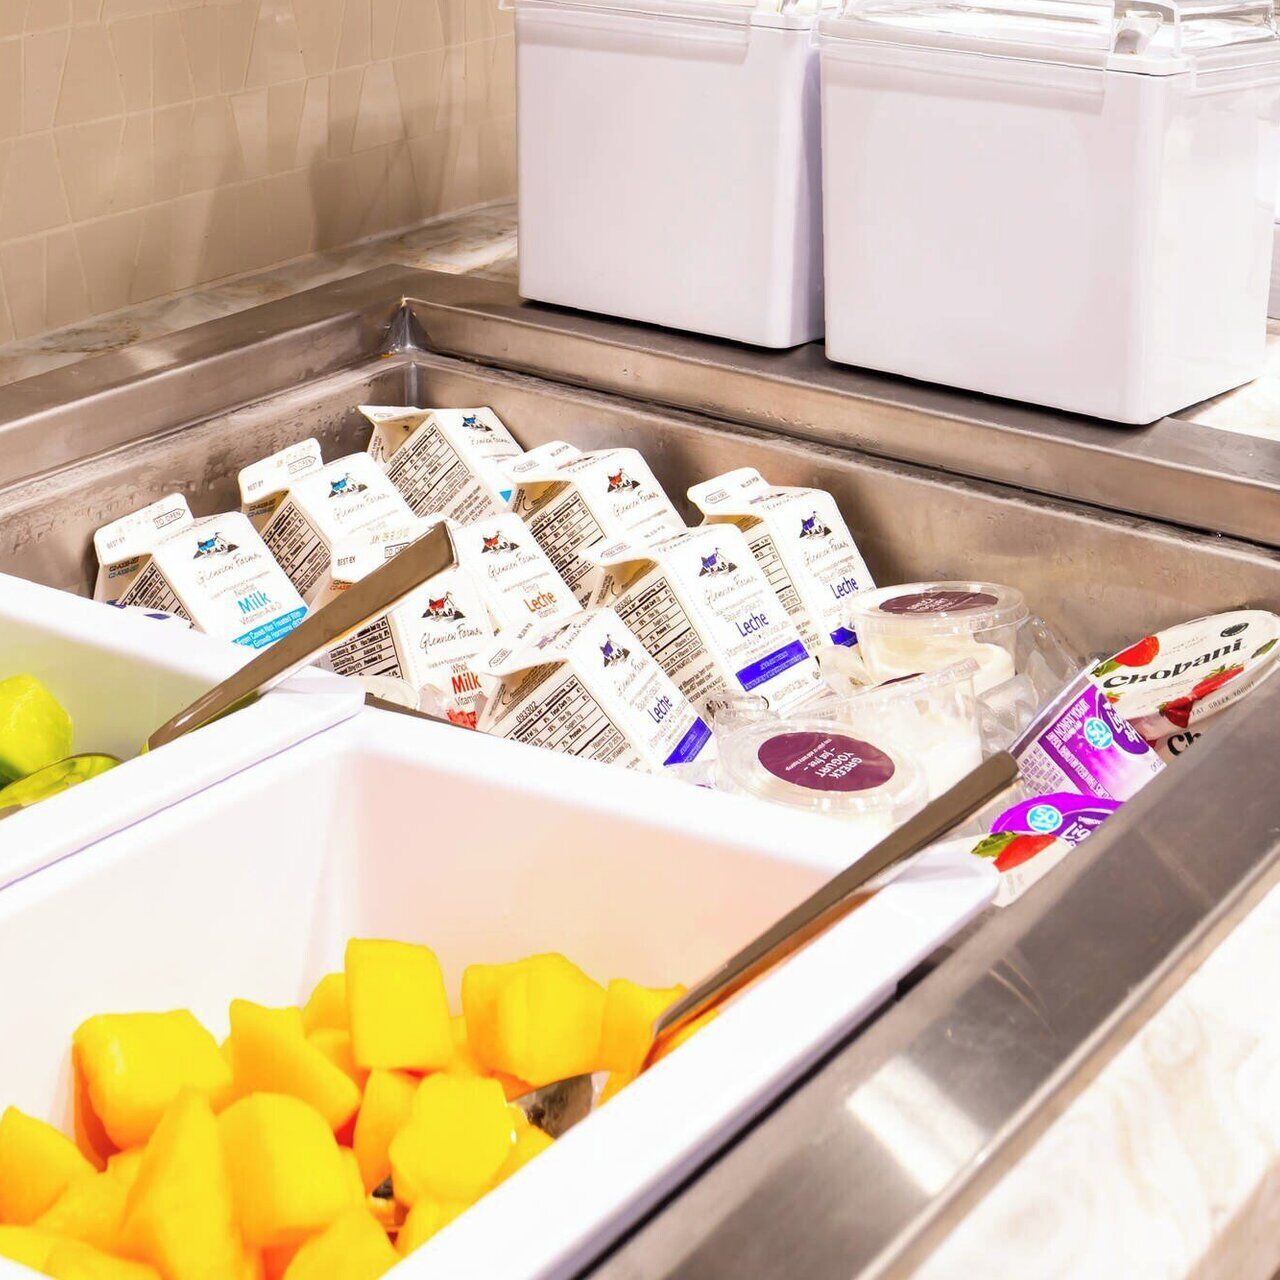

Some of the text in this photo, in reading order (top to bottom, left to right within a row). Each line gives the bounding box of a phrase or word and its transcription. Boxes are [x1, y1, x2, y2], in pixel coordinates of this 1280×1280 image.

[830, 576, 859, 599] Leche
[236, 589, 272, 614] Milk
[523, 591, 557, 613] Leche
[735, 612, 769, 637] Leche
[420, 623, 483, 654] Glenview Farms
[1103, 638, 1243, 688] Chobani
[451, 670, 482, 694] Milk
[515, 701, 538, 722] 093302
[647, 693, 673, 724] Leche
[1191, 706, 1205, 717] FAT
[1208, 694, 1229, 710] GREEK
[1167, 731, 1202, 756] Ch
[815, 751, 854, 777] YOGURT
[829, 757, 862, 779] GREEK
[1062, 822, 1091, 843] Lig
